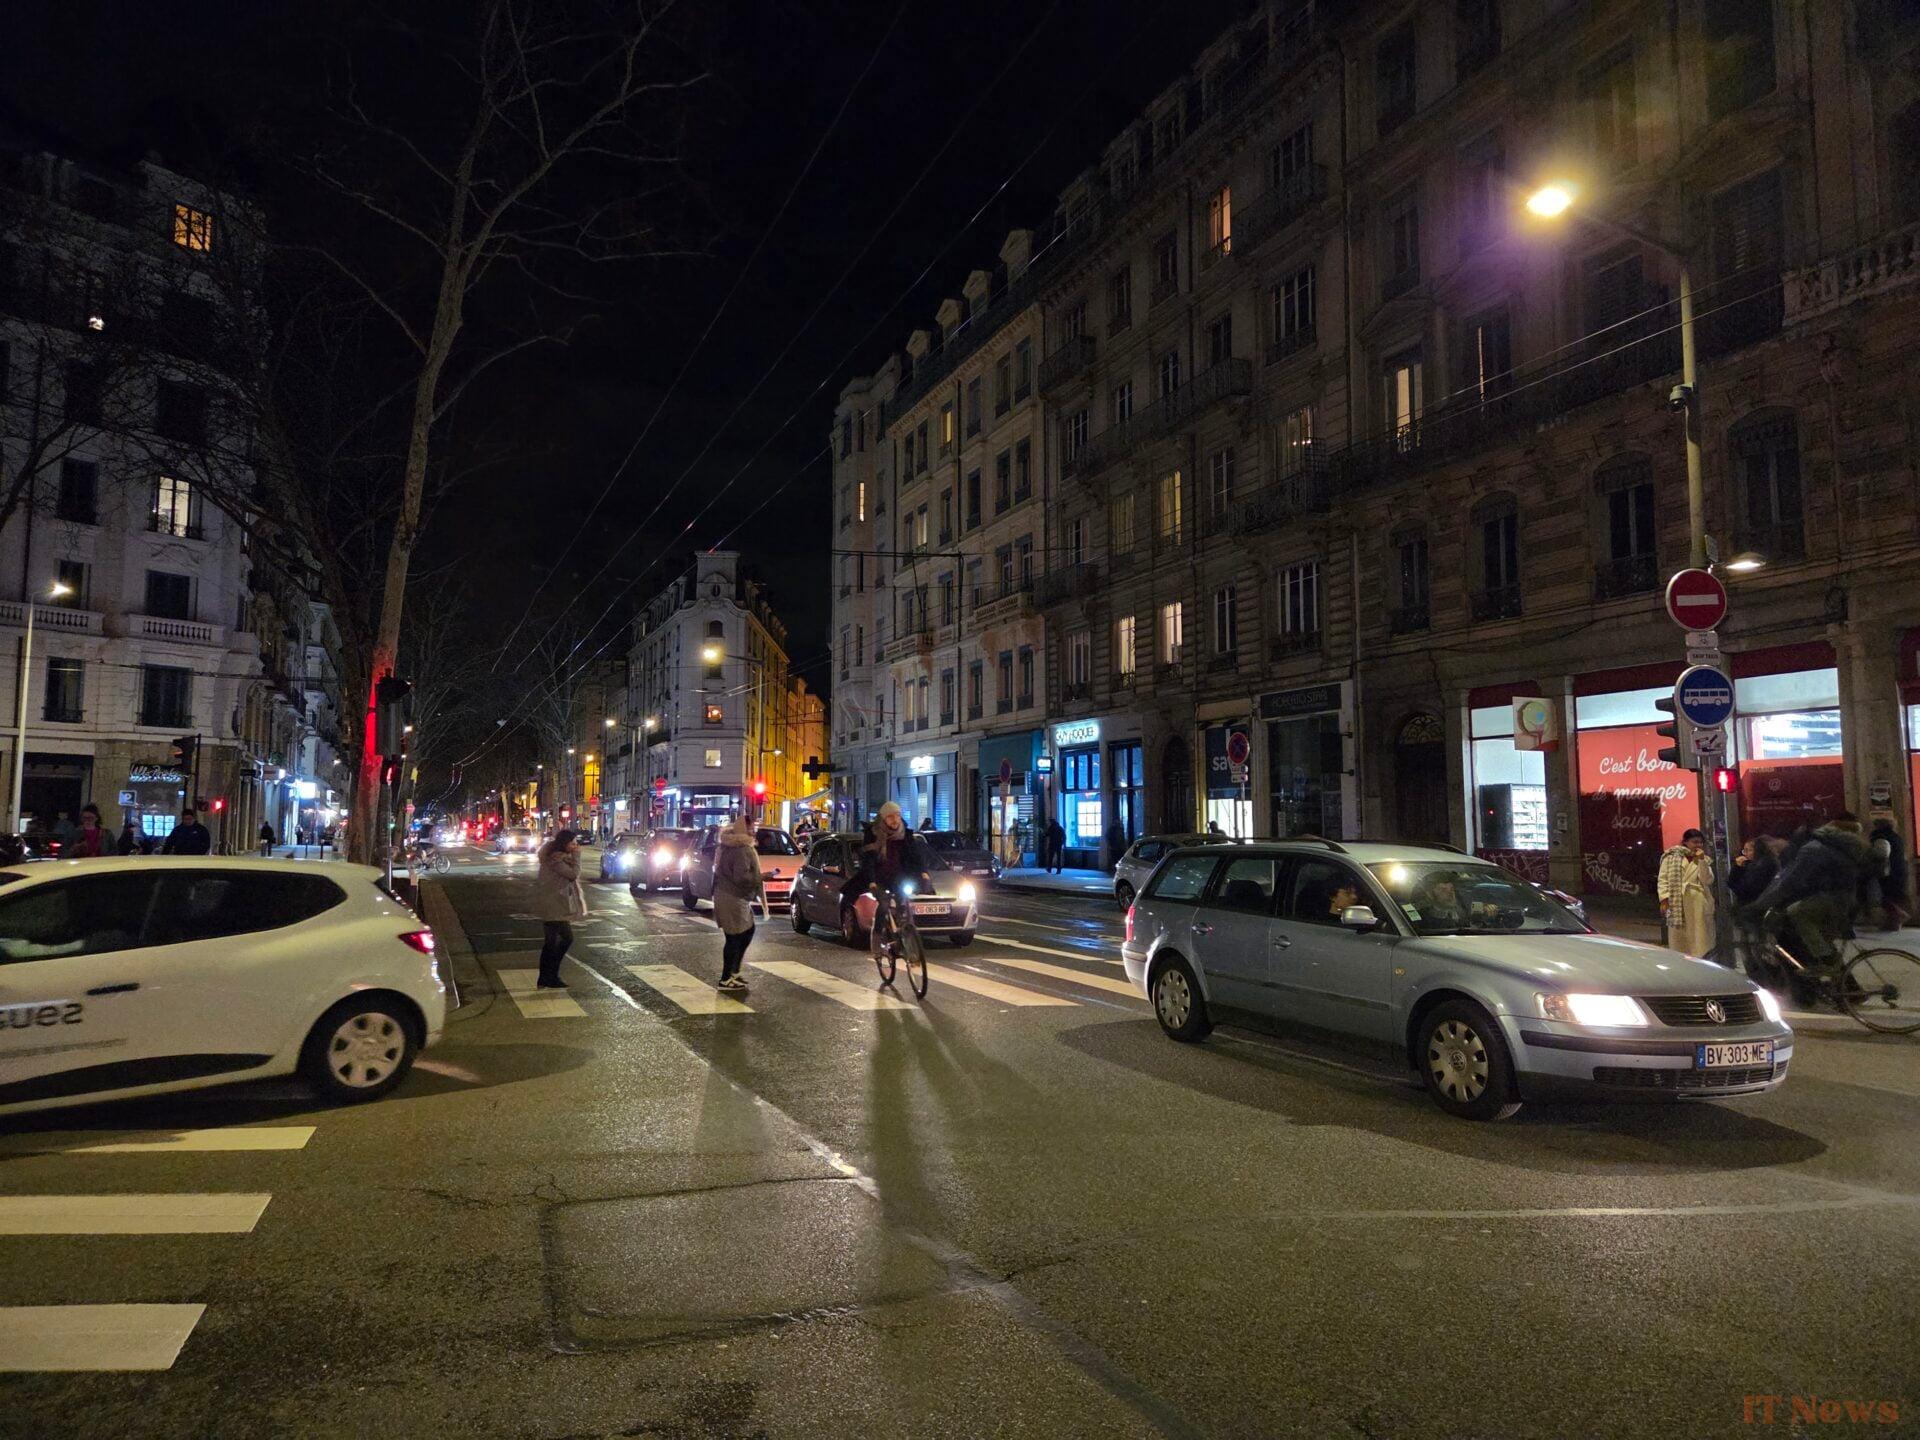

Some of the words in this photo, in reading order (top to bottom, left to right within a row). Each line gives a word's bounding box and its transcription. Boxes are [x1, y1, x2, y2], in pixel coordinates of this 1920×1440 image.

[1600, 756, 1632, 774] C'est
[1636, 748, 1677, 771] bon
[1613, 782, 1687, 810] manger
[1611, 812, 1652, 829] sain
